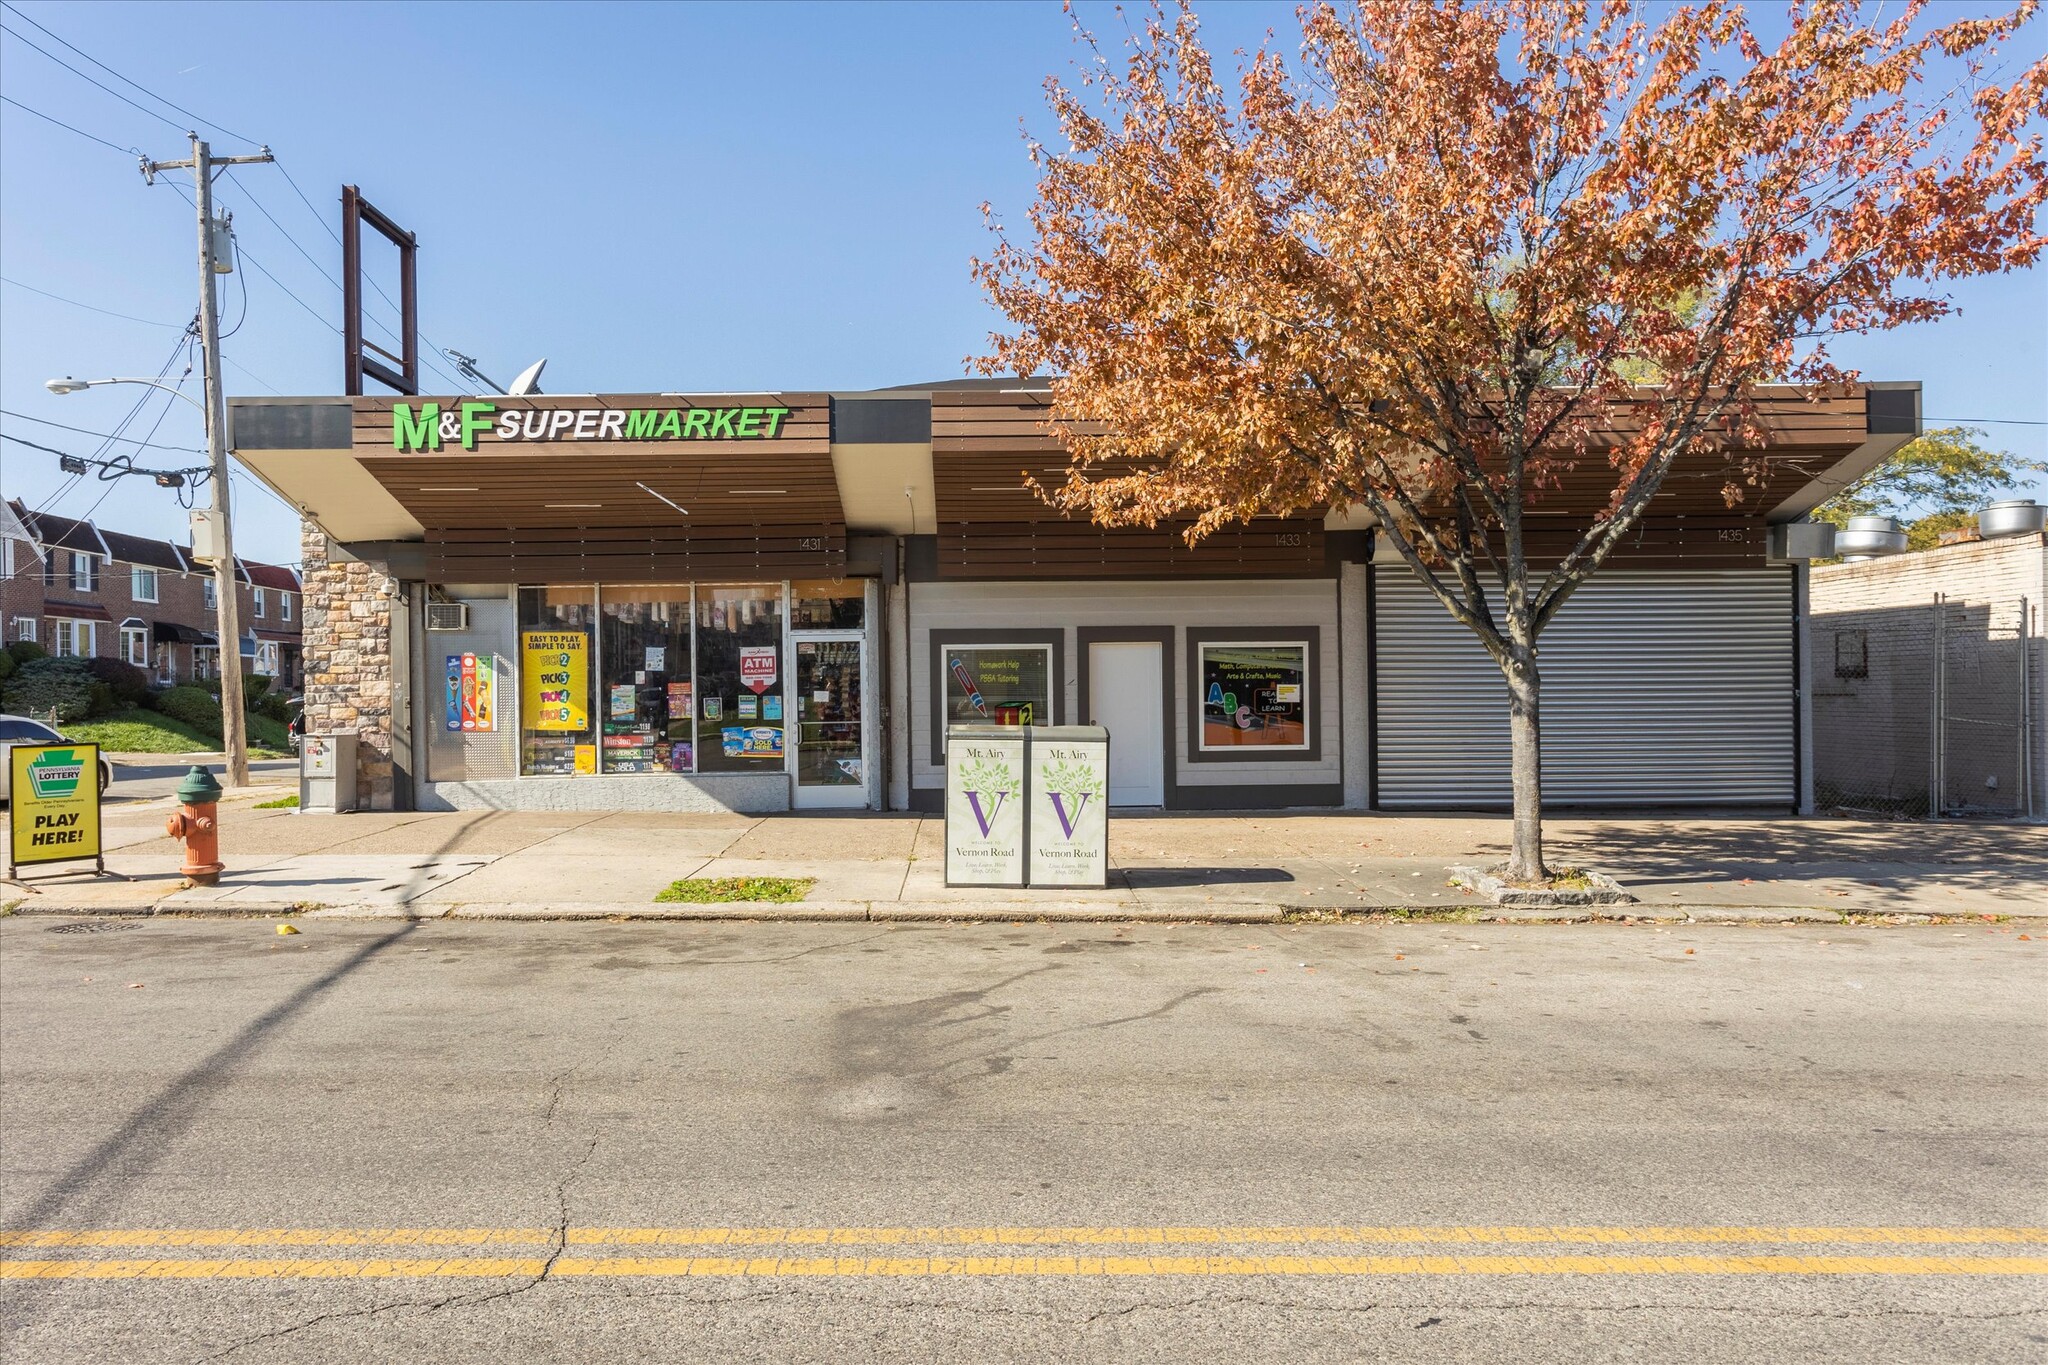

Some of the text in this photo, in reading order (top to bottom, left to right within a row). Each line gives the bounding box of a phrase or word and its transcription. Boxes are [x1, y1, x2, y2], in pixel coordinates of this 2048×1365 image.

[393, 402, 789, 449] M&F SUPERMARKET
[1275, 534, 1300, 546] 1433
[1718, 529, 1743, 541] 1435
[799, 538, 821, 551] 1431
[744, 658, 773, 668] ATM
[979, 660, 1020, 670] Homework Help
[997, 674, 1019, 684] Tutoring
[604, 737, 631, 745] Winston
[967, 748, 1005, 760] Mt. Airy
[1050, 750, 1088, 762] Mt. Airy
[39, 771, 80, 780] LOTTERY
[962, 790, 1009, 839] V
[1046, 792, 1093, 840] V
[35, 813, 80, 829] PLAY
[32, 830, 84, 846] HERE!
[956, 847, 1014, 857] Vernon Road
[1039, 849, 1097, 859] Vernon Road
